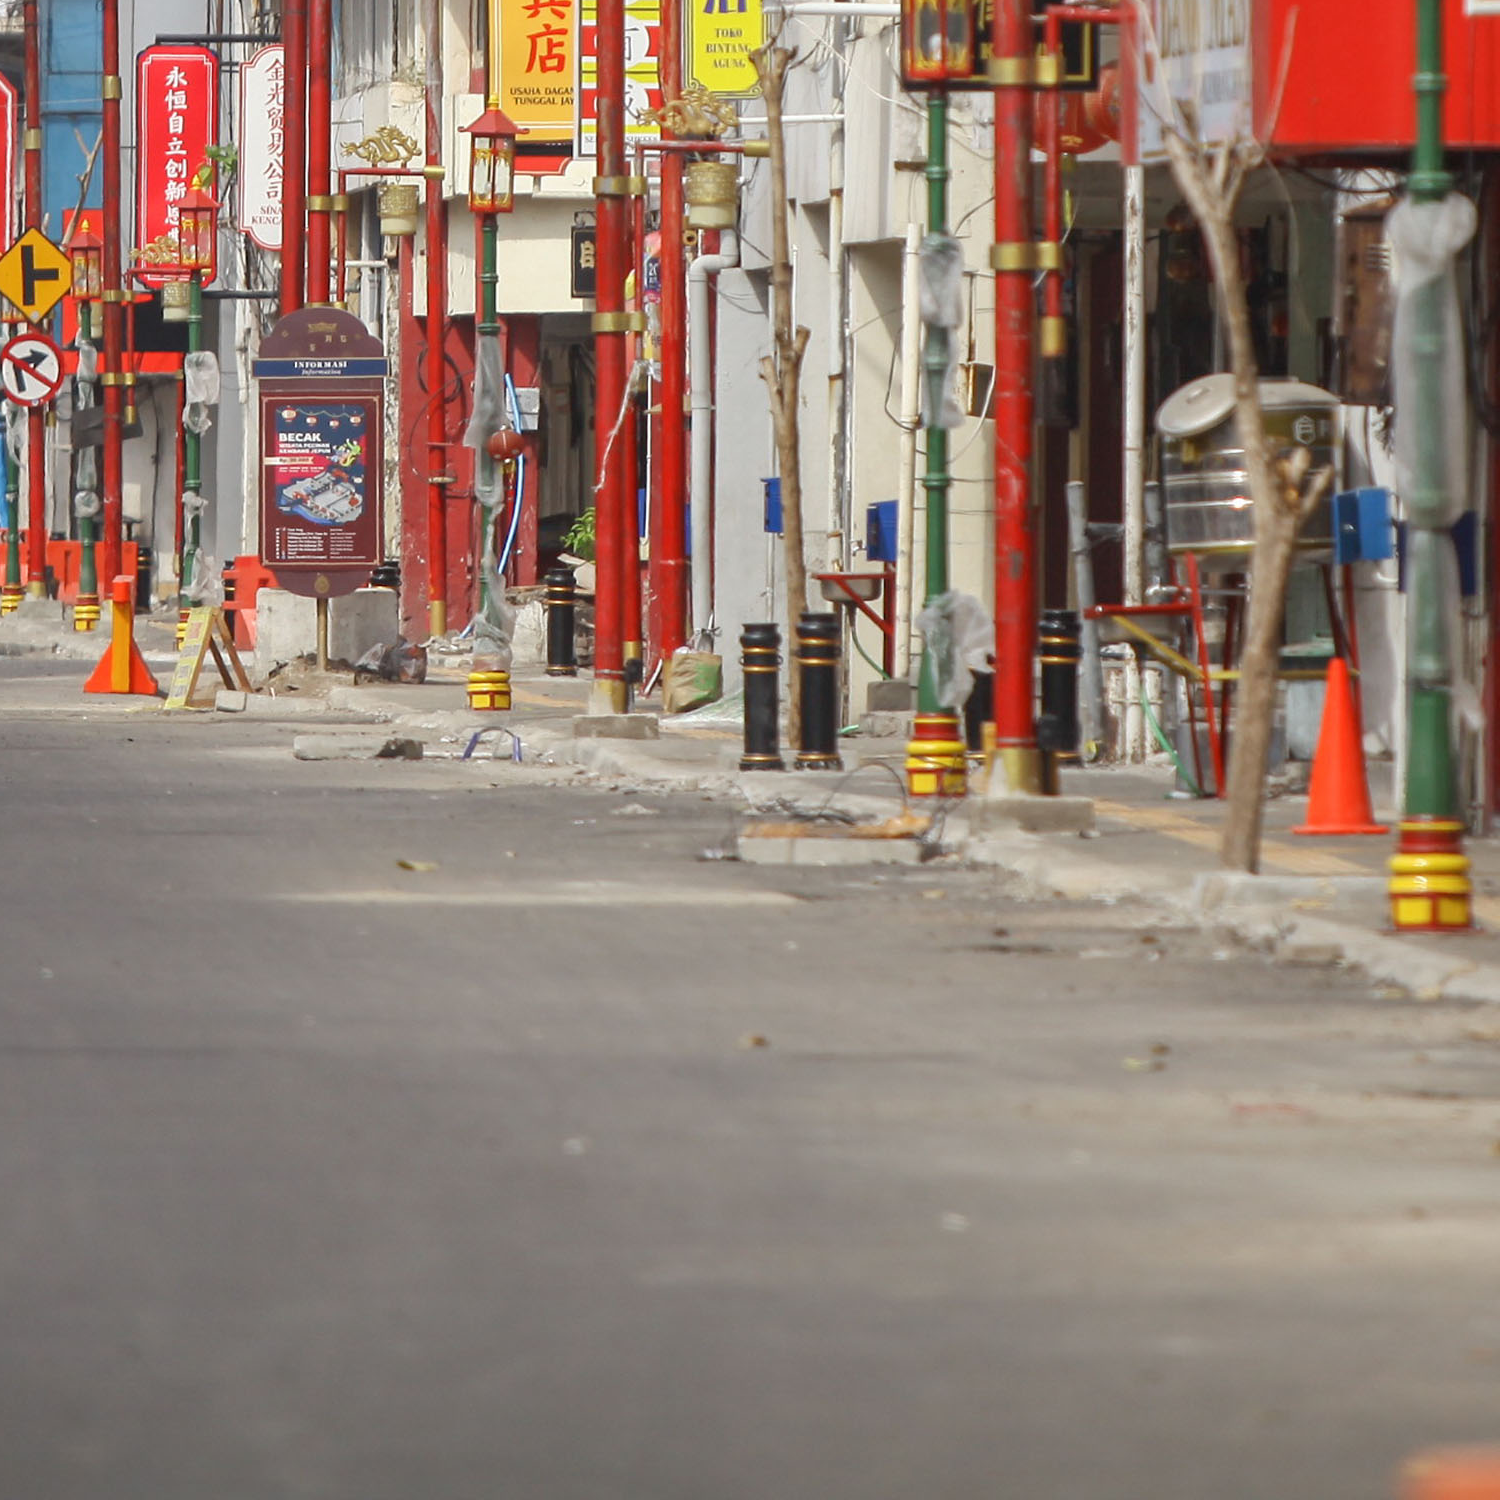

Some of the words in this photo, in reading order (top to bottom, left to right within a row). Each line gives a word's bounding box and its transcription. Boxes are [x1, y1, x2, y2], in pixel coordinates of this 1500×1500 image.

[715, 28, 743, 39] TOKO
[706, 44, 752, 54] BINTANG
[712, 58, 747, 69] AGUNG
[510, 87, 541, 96] USAHA
[545, 87, 573, 96] DAGAN
[514, 97, 559, 106] TUNGGAL
[560, 97, 574, 107] JAY
[294, 360, 347, 368] INFORMASI
[279, 433, 321, 442] BECAK
